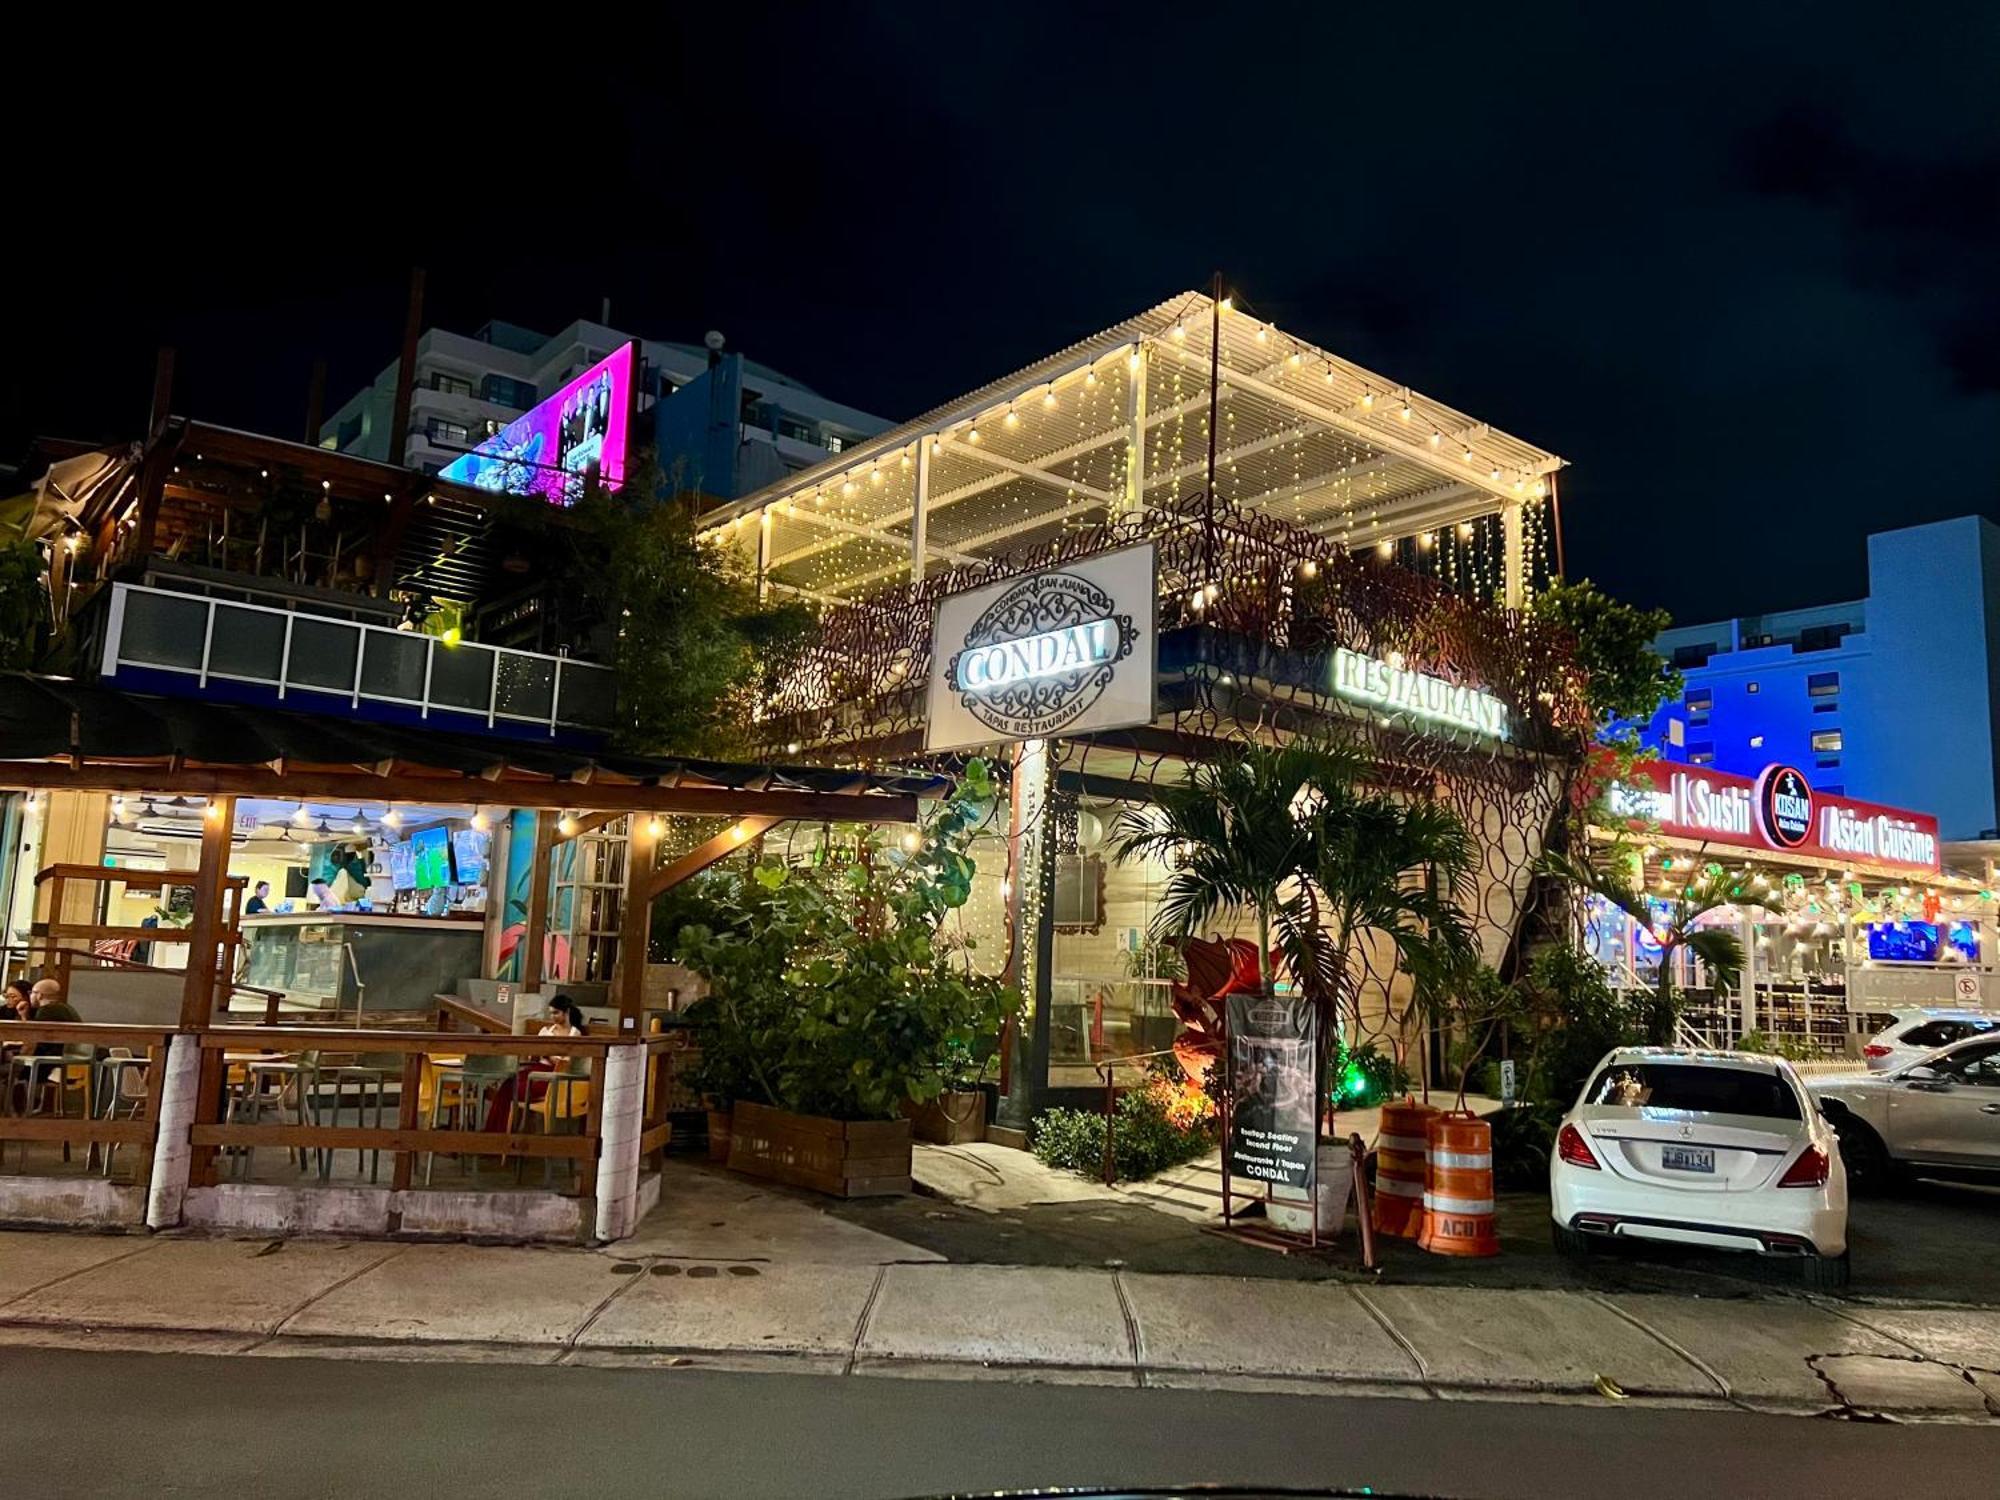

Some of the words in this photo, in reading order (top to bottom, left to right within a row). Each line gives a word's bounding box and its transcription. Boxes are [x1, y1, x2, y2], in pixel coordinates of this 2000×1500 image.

[1040, 578, 1059, 591] SAN
[964, 624, 1110, 686] CONDAL
[1340, 650, 1509, 736] RESTAURANT
[984, 708, 1009, 730] TAPAS
[1014, 698, 1083, 733] RESTAURANT
[1695, 779, 1750, 835] Sushi
[1775, 793, 1808, 820] KOSAN
[1826, 806, 1875, 856] Asian
[1877, 815, 1935, 865] Cuisine
[1267, 1131, 1298, 1144] Seating
[1246, 1164, 1290, 1182] CONDAL
